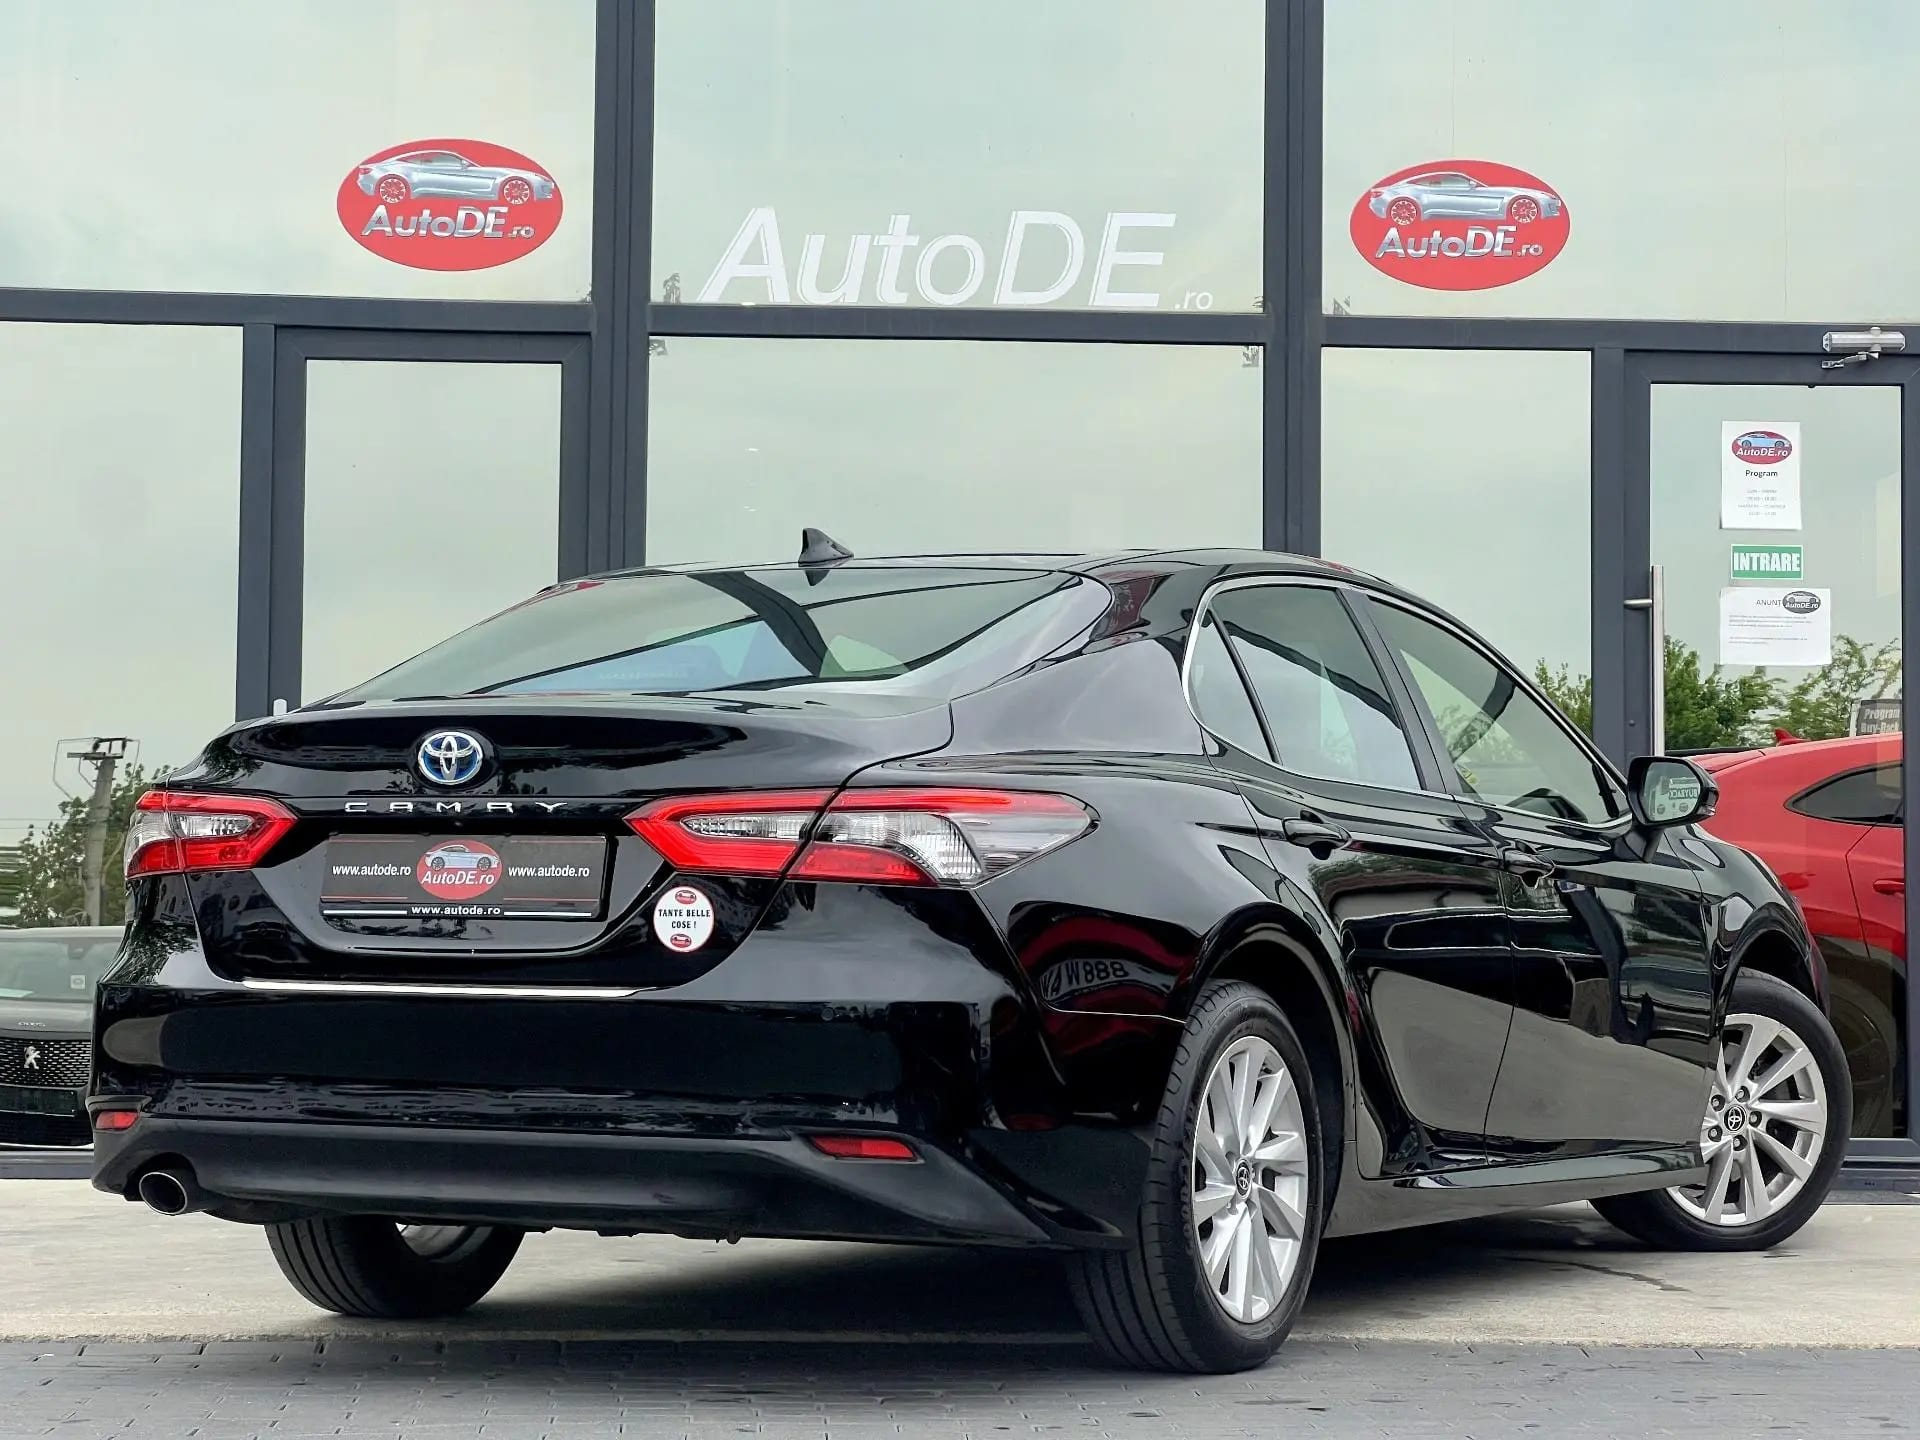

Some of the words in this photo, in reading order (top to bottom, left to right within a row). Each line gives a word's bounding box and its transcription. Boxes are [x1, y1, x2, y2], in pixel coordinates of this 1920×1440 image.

[1736, 447, 1789, 457] AutoDE.ro
[1745, 469, 1778, 479] Program
[1733, 552, 1801, 572] INTRARE
[1785, 602, 1819, 610] AutoDE.ro
[344, 801, 569, 814] CAMRY
[332, 863, 412, 876] www.autode.ro
[508, 864, 591, 878] www.autode.ro
[421, 870, 496, 886] AutoDE.ro
[411, 905, 501, 916] www.autode.ro
[658, 909, 684, 918] TANTE
[686, 909, 711, 918] BELLE
[671, 920, 692, 929] COSE
